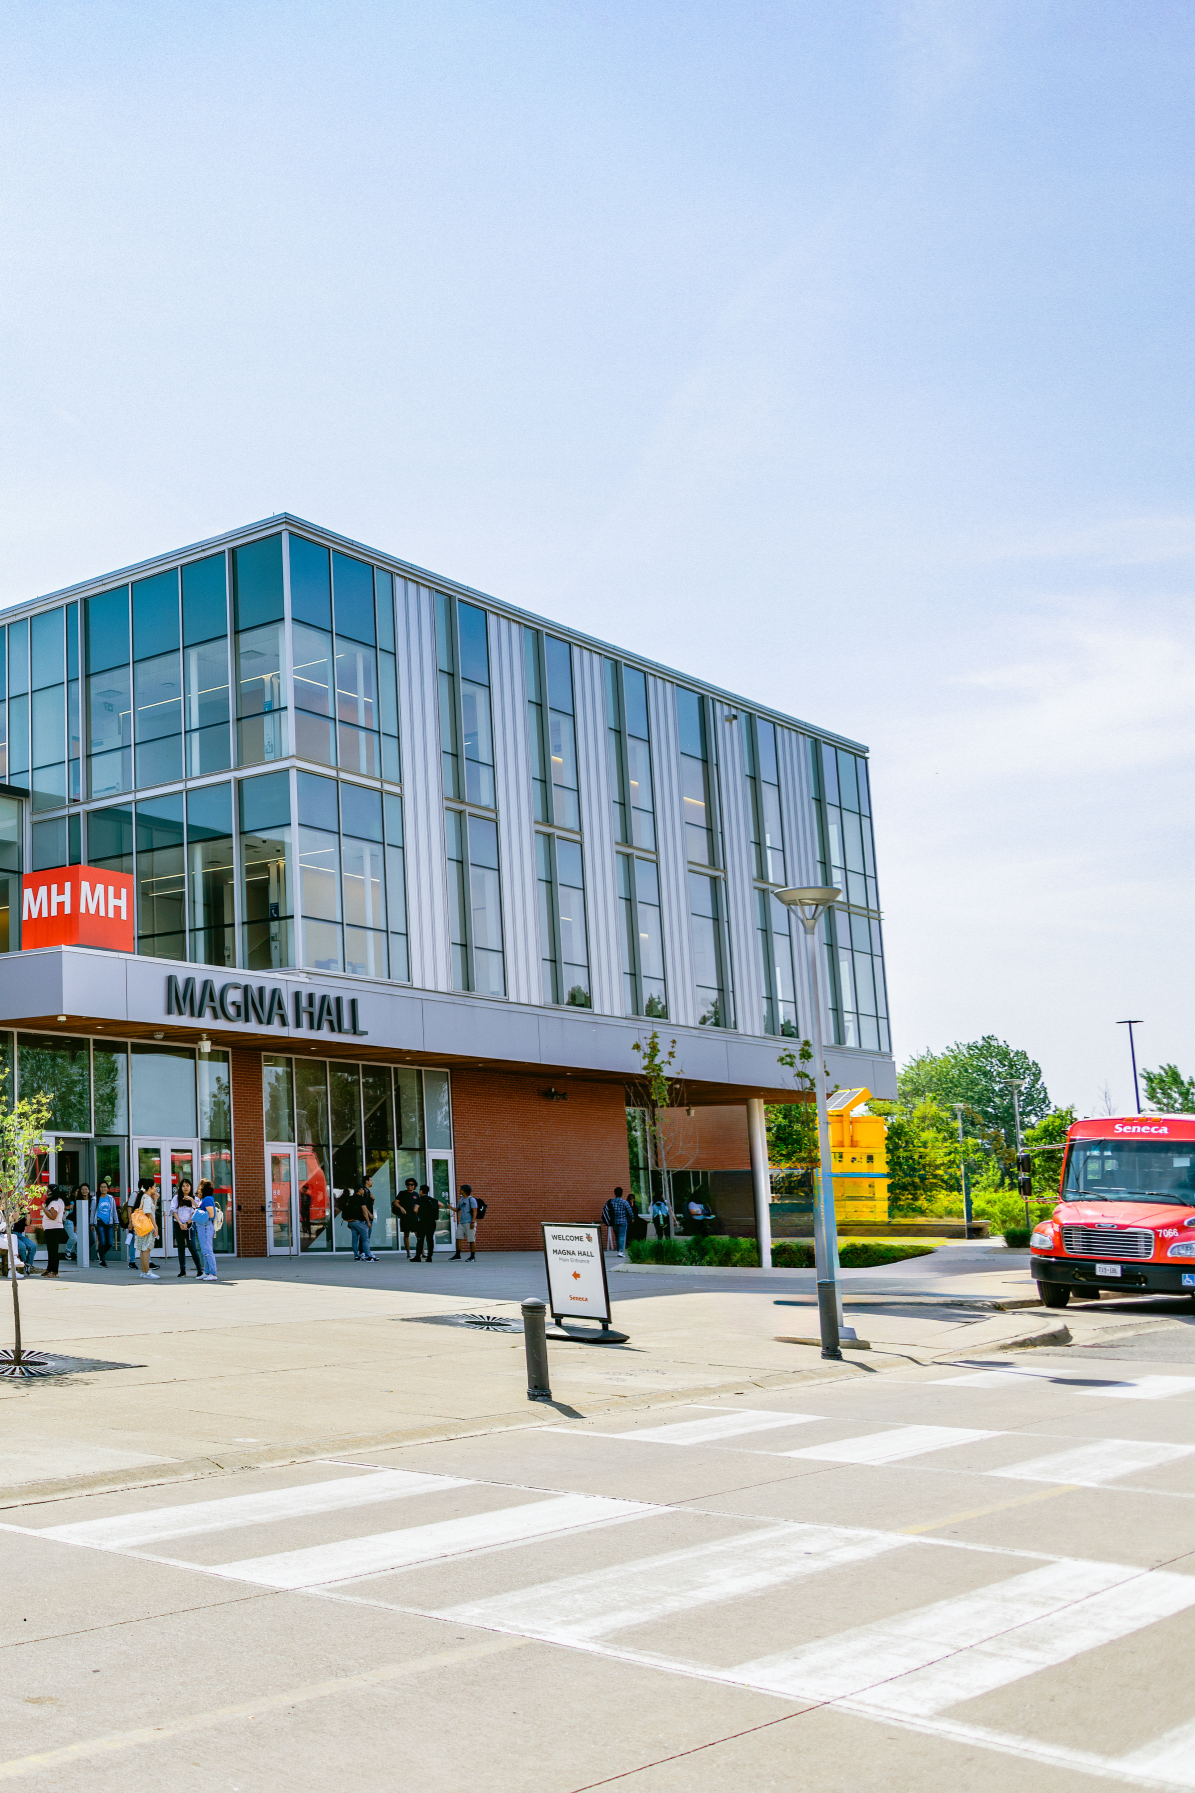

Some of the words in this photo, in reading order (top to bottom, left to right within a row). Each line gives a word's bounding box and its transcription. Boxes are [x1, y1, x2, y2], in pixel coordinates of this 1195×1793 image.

[22, 881, 71, 921] MH
[79, 880, 127, 920] MH
[167, 974, 290, 1027] MAGNA
[295, 990, 369, 1036] HALL
[1114, 1123, 1170, 1134] Seneca
[1155, 1228, 1179, 1238] 7066
